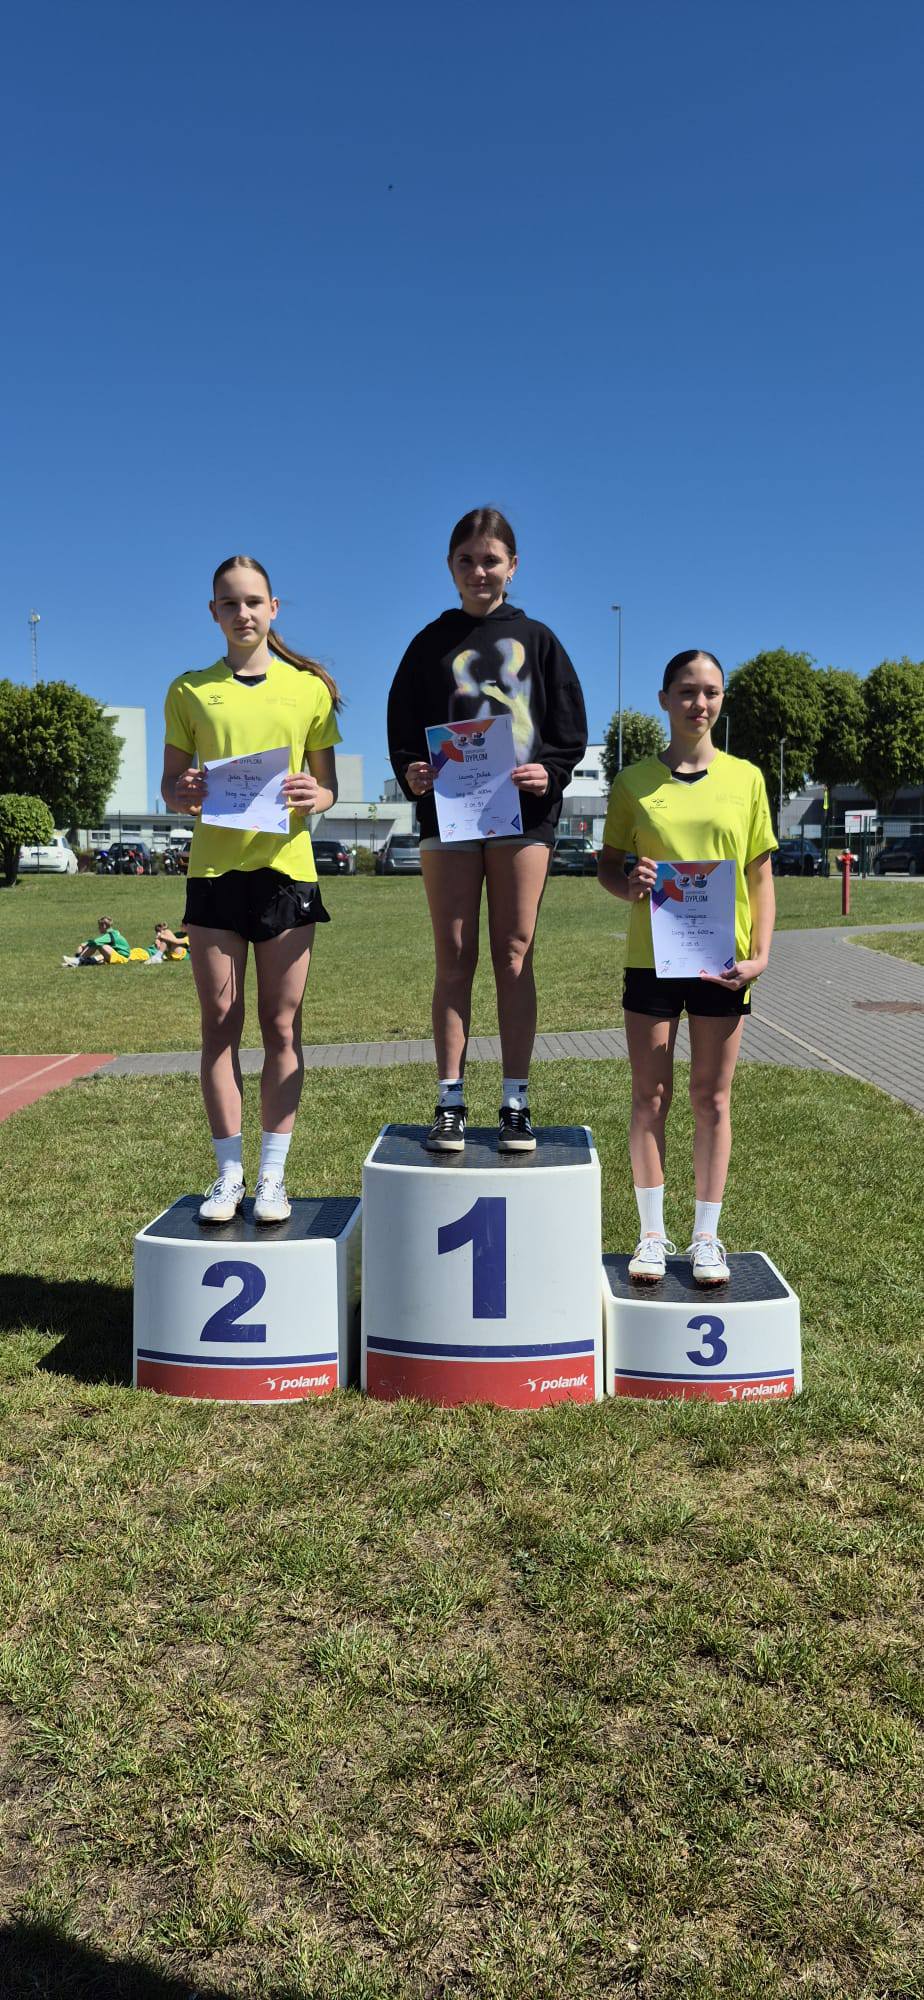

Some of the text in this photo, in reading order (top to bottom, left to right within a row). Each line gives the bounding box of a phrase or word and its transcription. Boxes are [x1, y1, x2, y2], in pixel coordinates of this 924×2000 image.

[465, 753, 488, 763] DYPLOM
[685, 895, 708, 903] DYPLOM
[438, 1197, 507, 1319] 1
[199, 1260, 267, 1343] 2
[686, 1315, 728, 1367] 3
[280, 1373, 330, 1392] polanik
[540, 1373, 589, 1392] polanik
[742, 1381, 788, 1399] polanik
